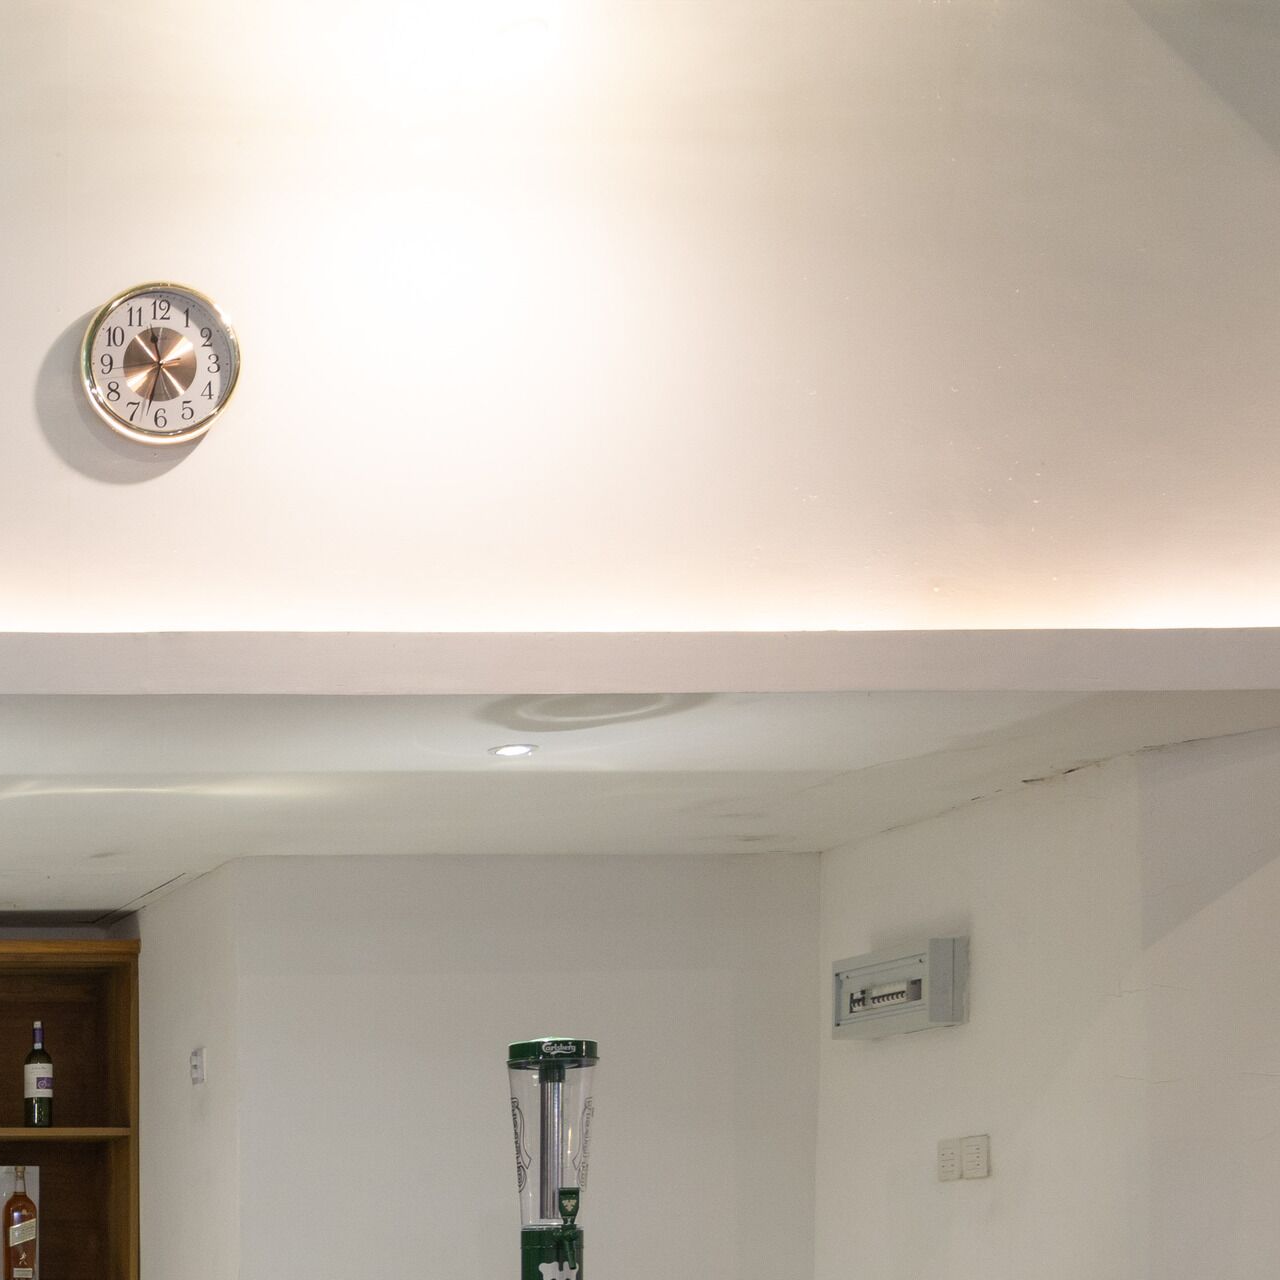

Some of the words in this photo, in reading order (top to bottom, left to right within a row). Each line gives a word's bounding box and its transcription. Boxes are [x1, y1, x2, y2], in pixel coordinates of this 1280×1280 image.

[127, 306, 143, 327] 11
[151, 299, 171, 321] 12
[183, 307, 190, 328] 1
[105, 326, 124, 347] 10
[201, 327, 212, 348] 2
[100, 353, 113, 375] 9
[207, 354, 220, 374] 3
[107, 381, 121, 402] 8
[201, 380, 214, 400] 4
[126, 401, 140, 422] 7
[154, 408, 167, 429] 6
[181, 400, 194, 421] 5
[542, 1042, 576, 1055] Carlsberg
